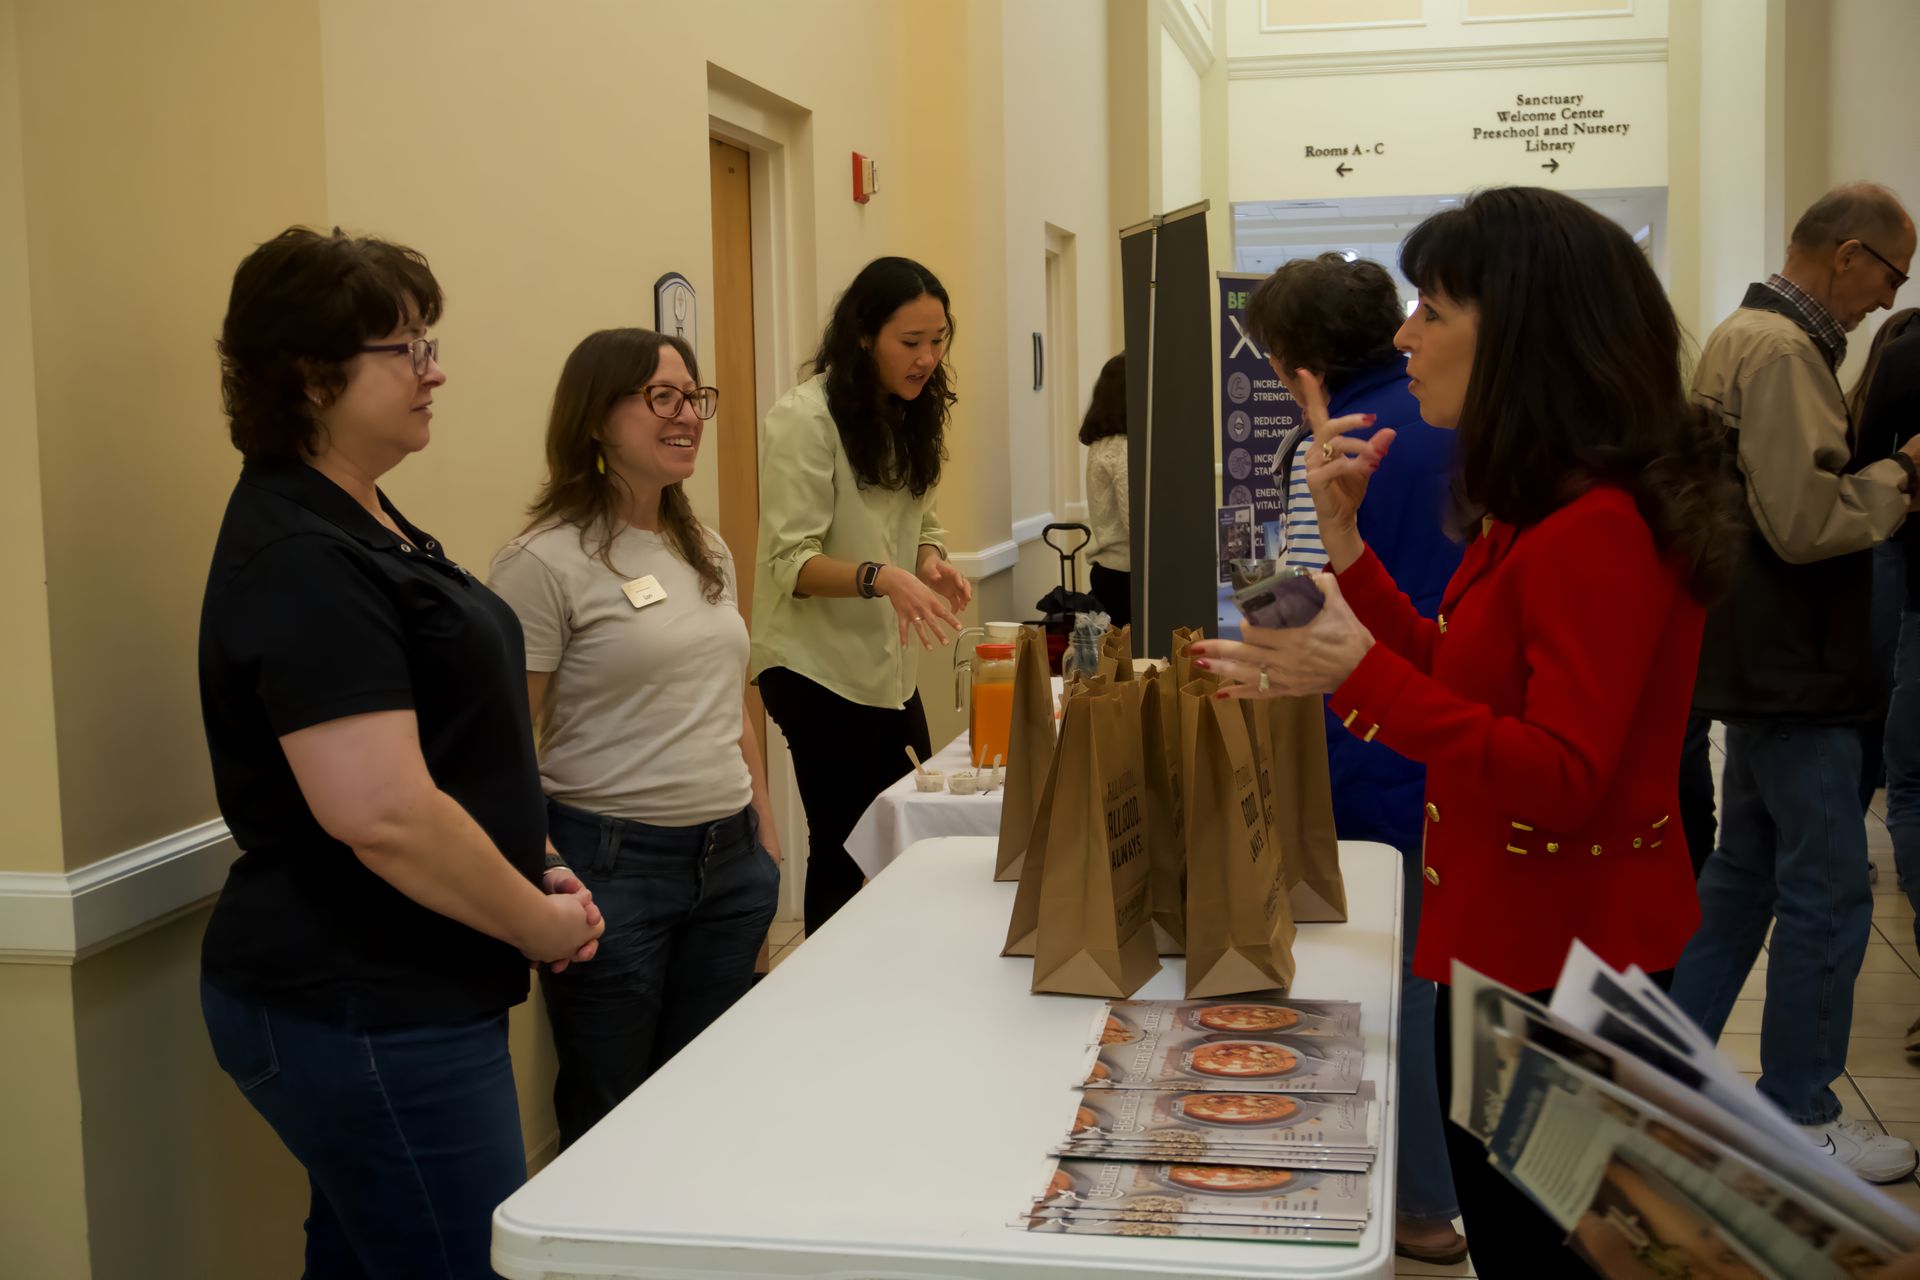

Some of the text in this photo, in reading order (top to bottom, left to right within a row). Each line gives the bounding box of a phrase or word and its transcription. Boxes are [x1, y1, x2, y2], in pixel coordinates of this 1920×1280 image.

[1516, 94, 1584, 107] Sanctuary
[1497, 107, 1605, 123] Welcome Center
[1472, 122, 1631, 140] Preschool and Nursery
[1304, 145, 1349, 158] Rooms
[1352, 143, 1363, 156] A
[1374, 142, 1385, 155] C
[1525, 140, 1576, 154] Library
[1253, 380, 1288, 389] INCREA
[1254, 416, 1293, 425] REDUCED
